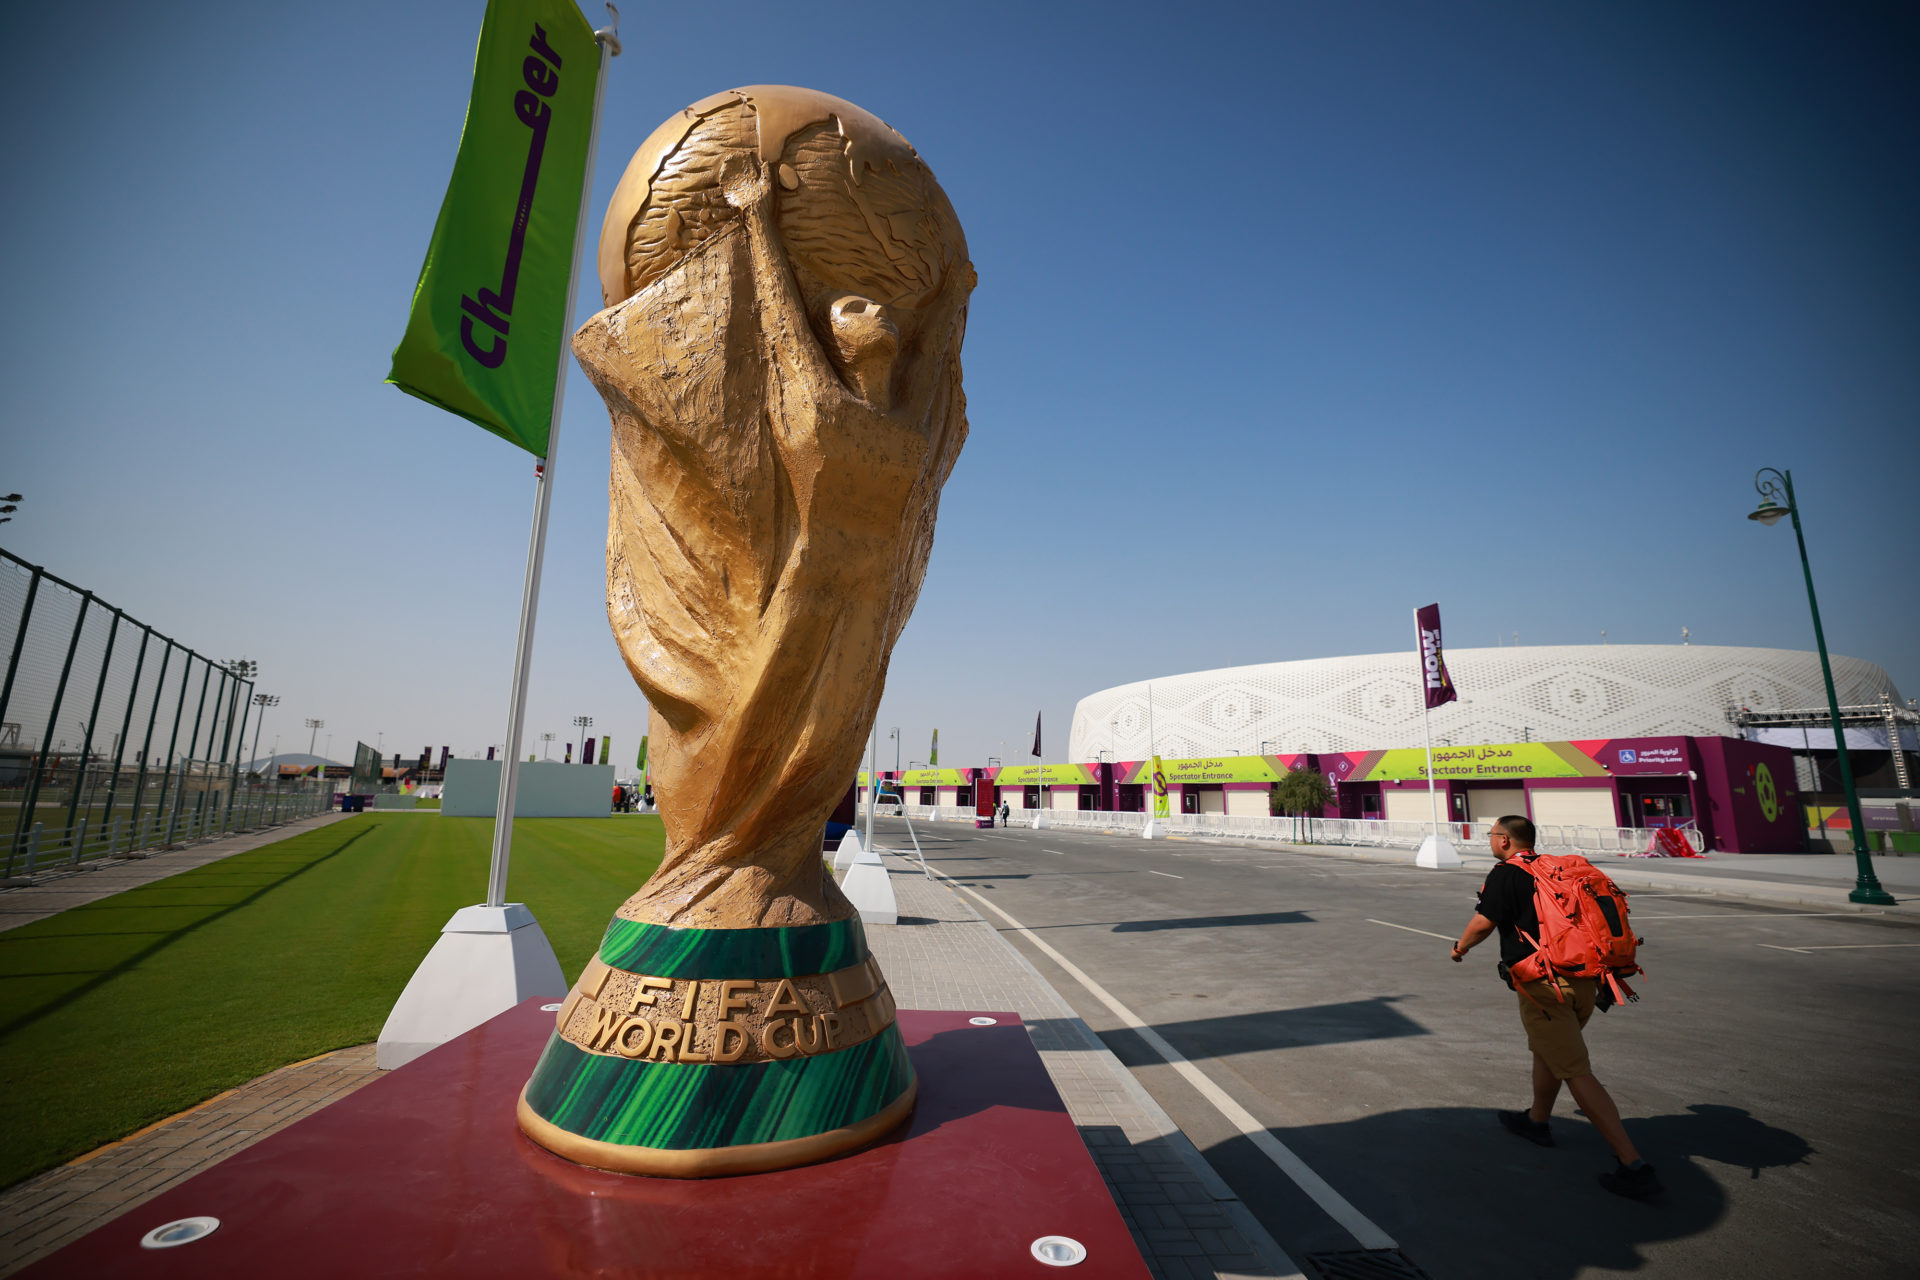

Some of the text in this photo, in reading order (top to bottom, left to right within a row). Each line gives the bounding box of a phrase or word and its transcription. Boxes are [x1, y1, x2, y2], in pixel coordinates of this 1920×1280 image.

[459, 22, 562, 369] Cheer
[1433, 747, 1513, 762] مدخل الجمهور
[1476, 764, 1533, 774] Entrance
[1169, 772, 1233, 781] Spectator Entrance
[628, 977, 809, 1020] FIFA
[588, 1007, 844, 1064] WORLD CUP
